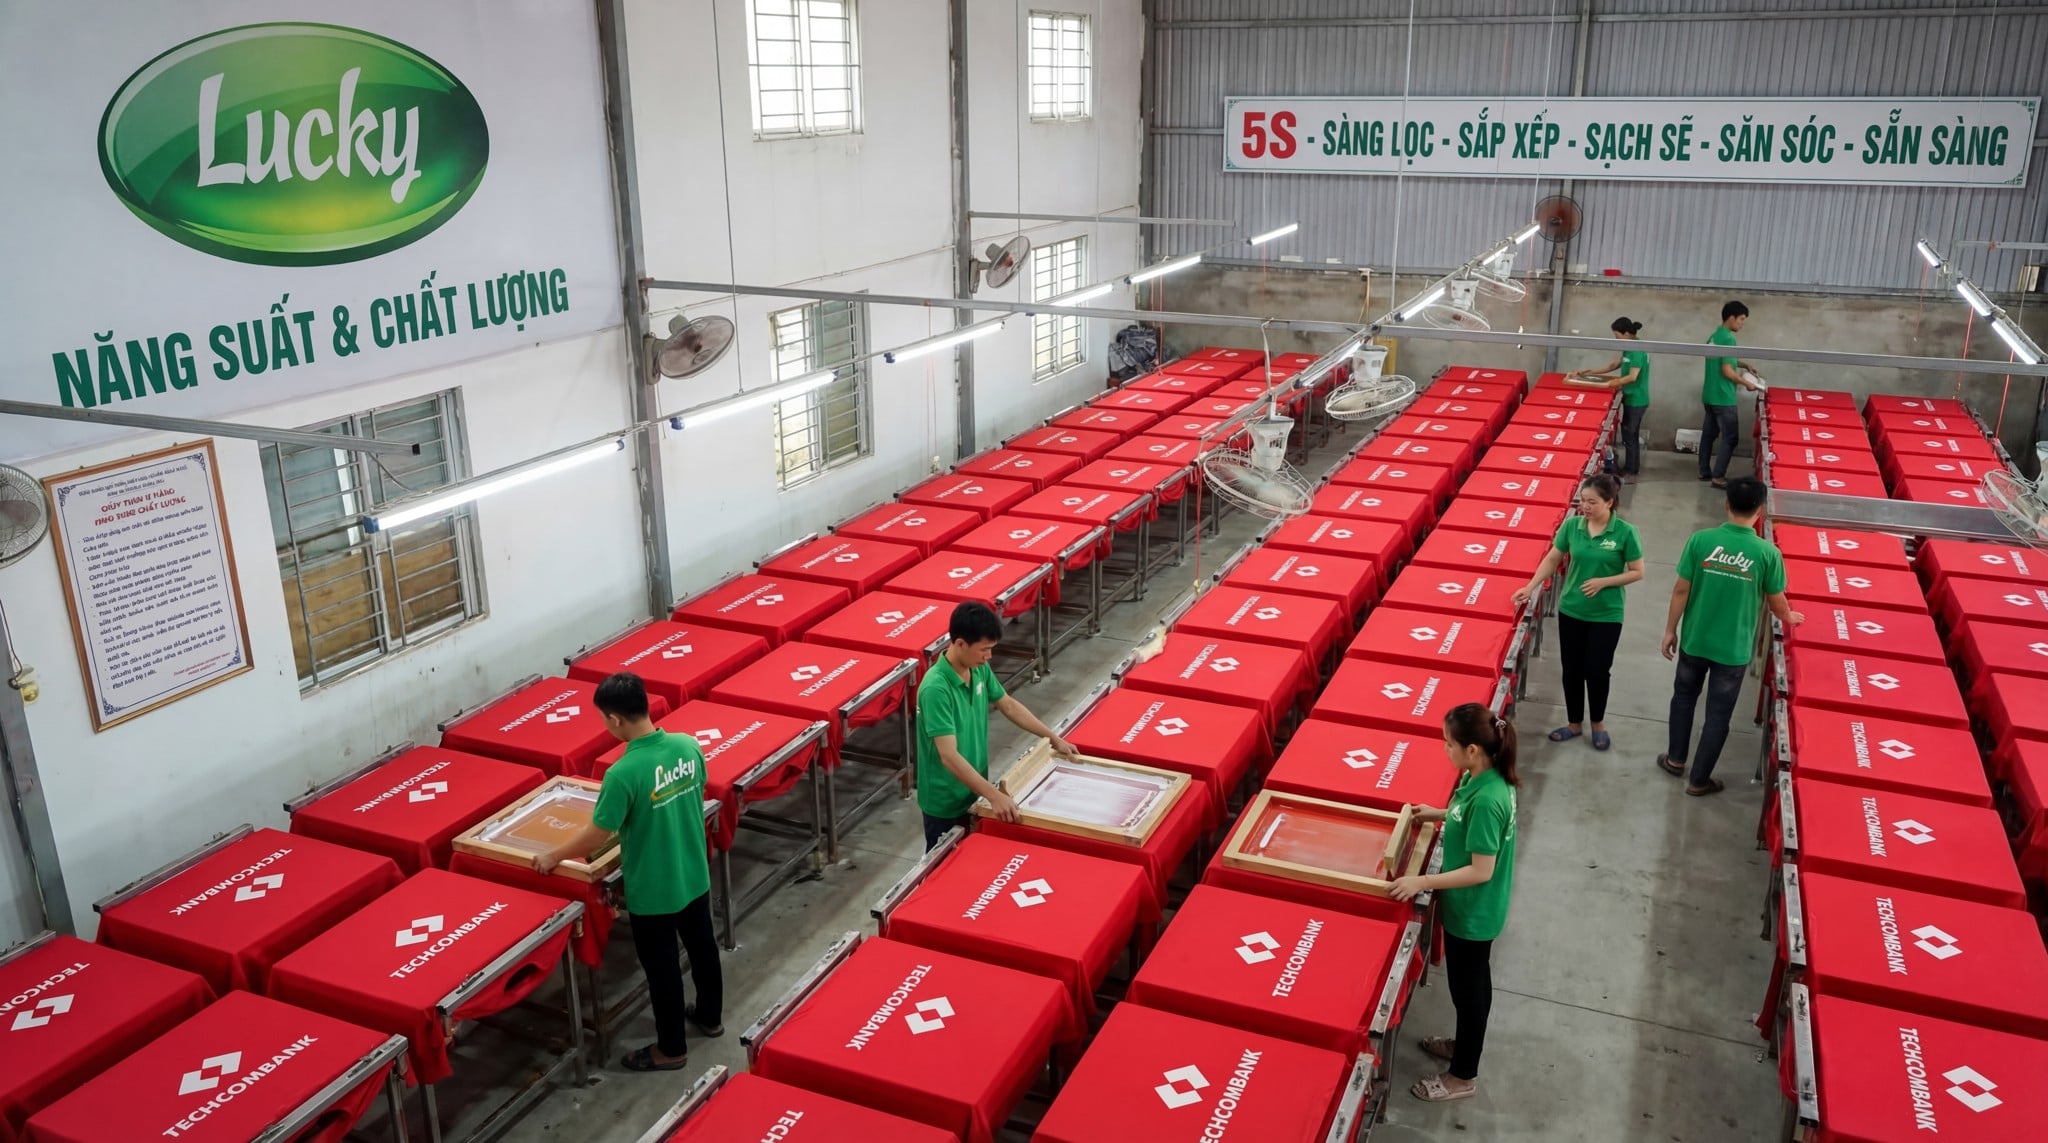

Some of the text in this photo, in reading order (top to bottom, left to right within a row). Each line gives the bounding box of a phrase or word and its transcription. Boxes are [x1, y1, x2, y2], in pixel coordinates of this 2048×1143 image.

[197, 67, 422, 204] Lucky
[1241, 111, 1297, 159] 5S
[1323, 112, 1385, 157] SÀNG
[1391, 121, 1435, 166] LỌC
[1457, 107, 1506, 159] SẮP
[1512, 109, 1560, 160] XẾP
[1584, 122, 1653, 169] SẠCH
[1659, 115, 1694, 162] SẼ
[1718, 115, 1775, 163] SĂN
[1780, 114, 1836, 164] SÓC
[1862, 108, 1922, 165] SẴN
[1928, 115, 2009, 167] SÀNG
[52, 268, 569, 409] NĂNG SUẤT & CHẤT LƯỢNG
[1704, 545, 1754, 572] Lucky
[655, 757, 695, 793] Lucky
[1861, 796, 1888, 858] TECHCOMBANK
[169, 848, 292, 916] TECHCOMBANK
[962, 853, 1030, 921] TECHCOMBANK
[389, 901, 509, 979] TECHCOMBANK
[1271, 918, 1325, 998] TECHCOMBANK
[1875, 896, 1909, 976] TECHCOMBANK
[844, 964, 933, 1052] TECHCOMBANK
[162, 1033, 319, 1138] TECHCOMBANK
[1898, 1026, 1939, 1134] TECHCOMBANK
